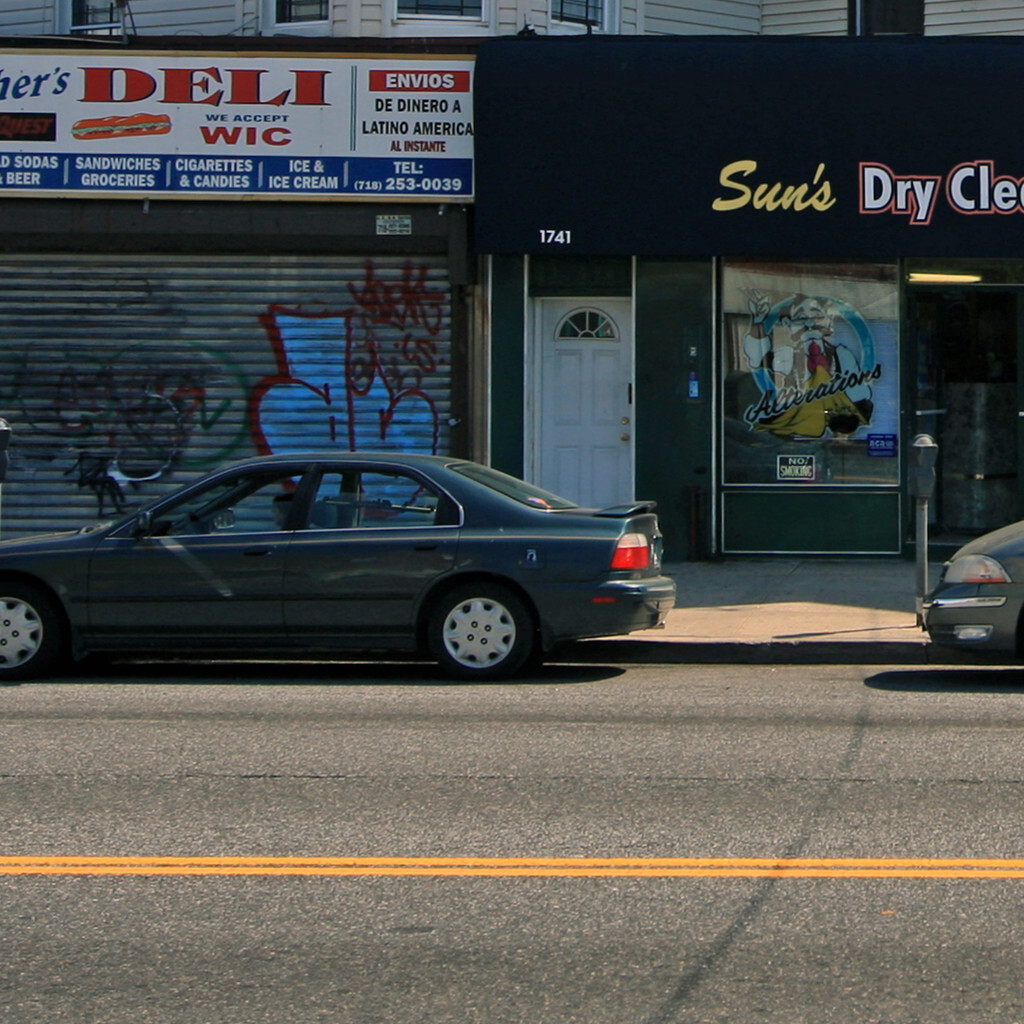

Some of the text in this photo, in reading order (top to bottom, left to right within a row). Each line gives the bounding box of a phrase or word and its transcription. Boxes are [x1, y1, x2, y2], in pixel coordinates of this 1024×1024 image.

[77, 66, 333, 107] DELI
[385, 72, 455, 89] ENVIOS
[375, 98, 462, 113] DE DINERO A
[205, 114, 289, 123] WE ACCEPT
[362, 121, 474, 136] LATINO AMERICA
[200, 126, 292, 146] WIC
[390, 140, 446, 153] AL INSTANTE
[0, 156, 59, 169] D SODAS
[75, 157, 161, 171] SANDWICHES
[175, 158, 253, 172] CIGARETTES
[289, 160, 325, 173] ICE &
[393, 161, 423, 175] TEL:
[6, 172, 41, 185] BEER
[81, 173, 155, 187] GROCERIES
[179, 174, 250, 188] & CANDIES
[269, 176, 338, 189] ICE CREAM
[354, 178, 462, 192] (718) 253-0039
[712, 159, 837, 212] Sun's
[862, 164, 937, 222] Dry
[539, 229, 571, 245] 1741
[745, 363, 882, 423] Alterations
[788, 457, 805, 465] NO
[780, 465, 812, 477] SMOKING
